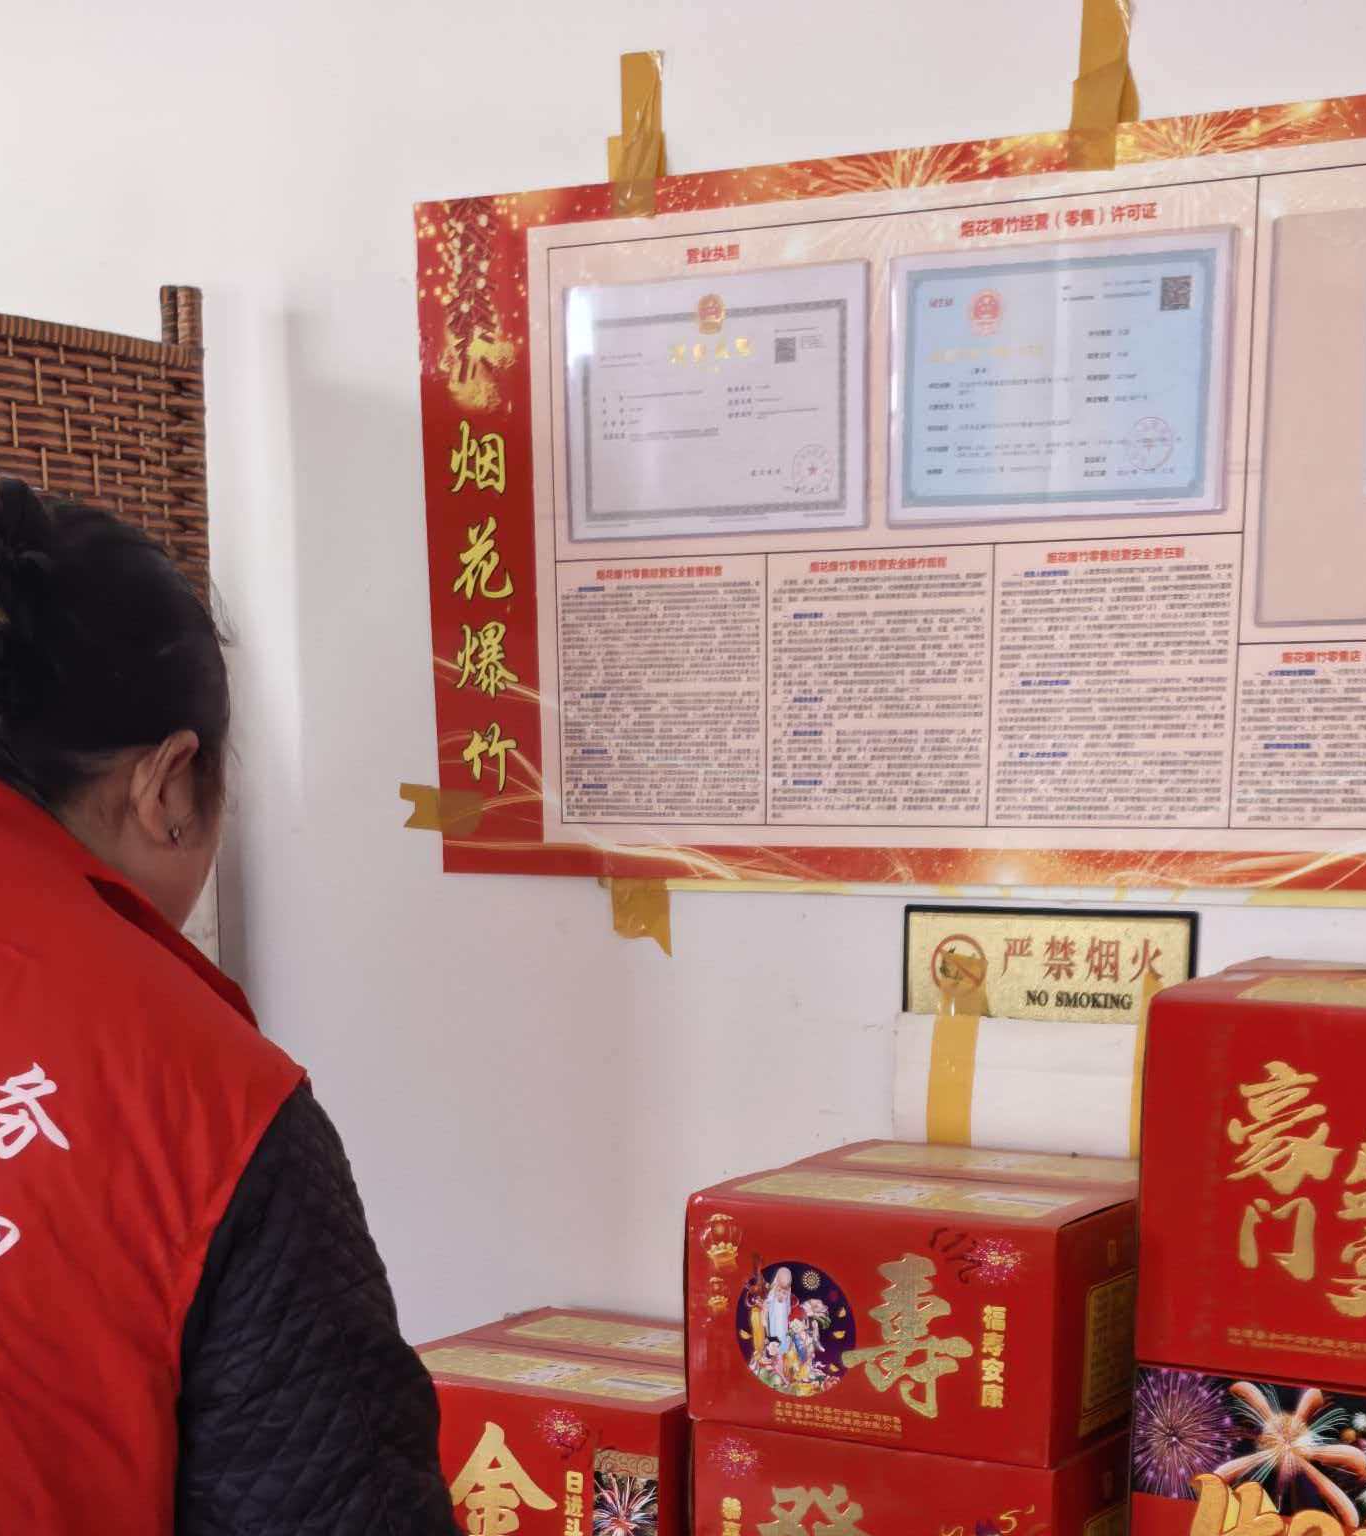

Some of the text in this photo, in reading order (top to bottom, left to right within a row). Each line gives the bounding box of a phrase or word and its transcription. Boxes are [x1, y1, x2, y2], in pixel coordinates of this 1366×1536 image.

[686, 244, 740, 265] 营业执照
[450, 420, 521, 793] 烟花爆竹
[1001, 935, 1164, 983] 严禁烟火
[1025, 990, 1134, 1011] NO SMOKING
[1226, 1060, 1342, 1281] 豪门
[842, 1253, 973, 1418] 寿
